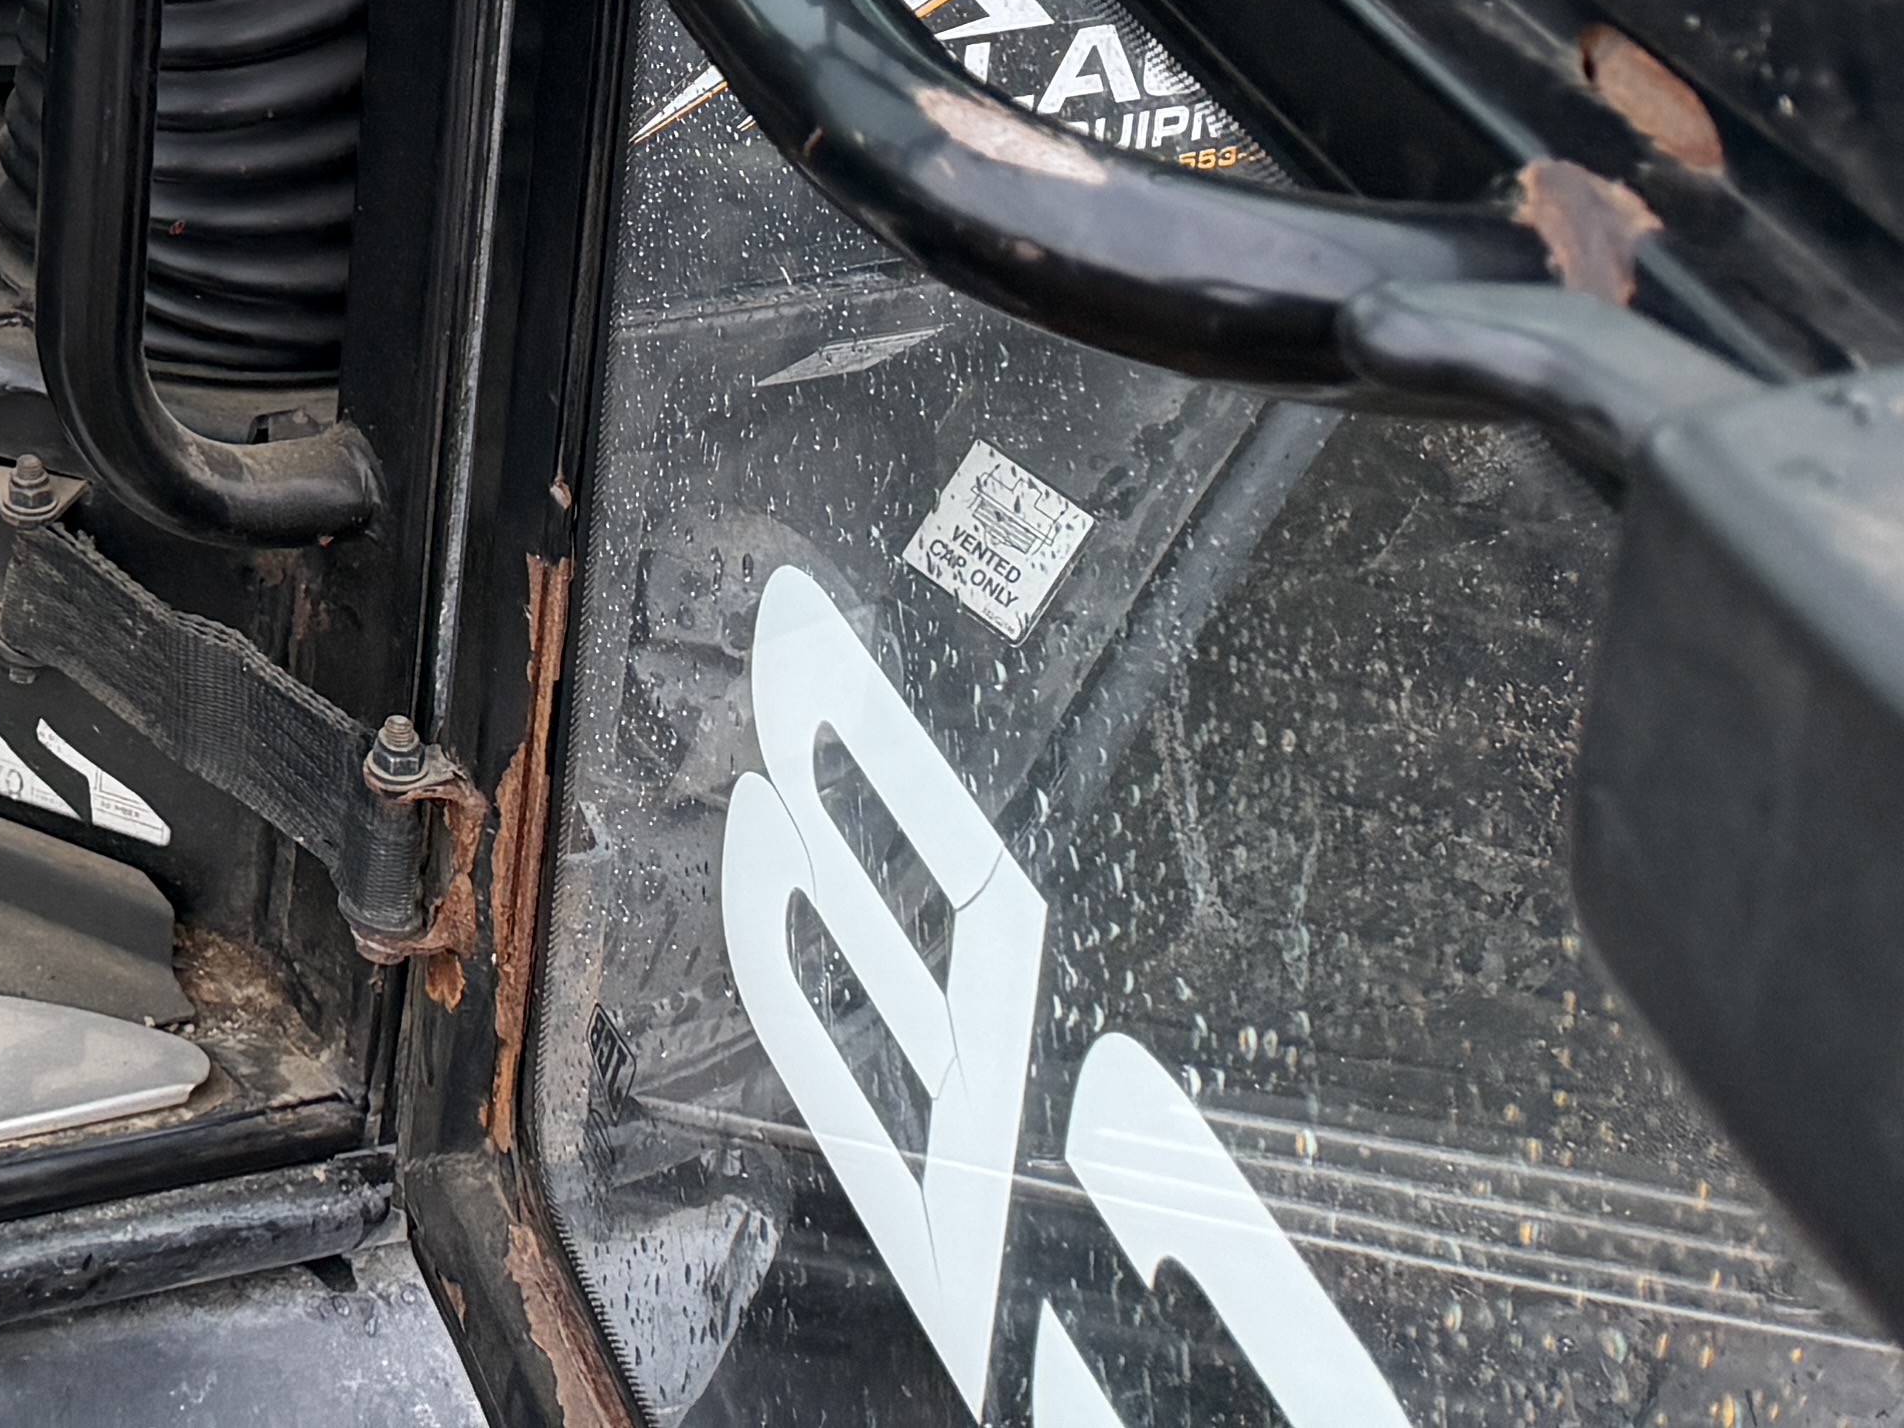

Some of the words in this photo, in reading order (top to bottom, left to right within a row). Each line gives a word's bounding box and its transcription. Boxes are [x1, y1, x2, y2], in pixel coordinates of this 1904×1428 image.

[929, 538, 967, 574] CAP
[970, 568, 1019, 608] ONLY
[952, 524, 1022, 584] VENTED
